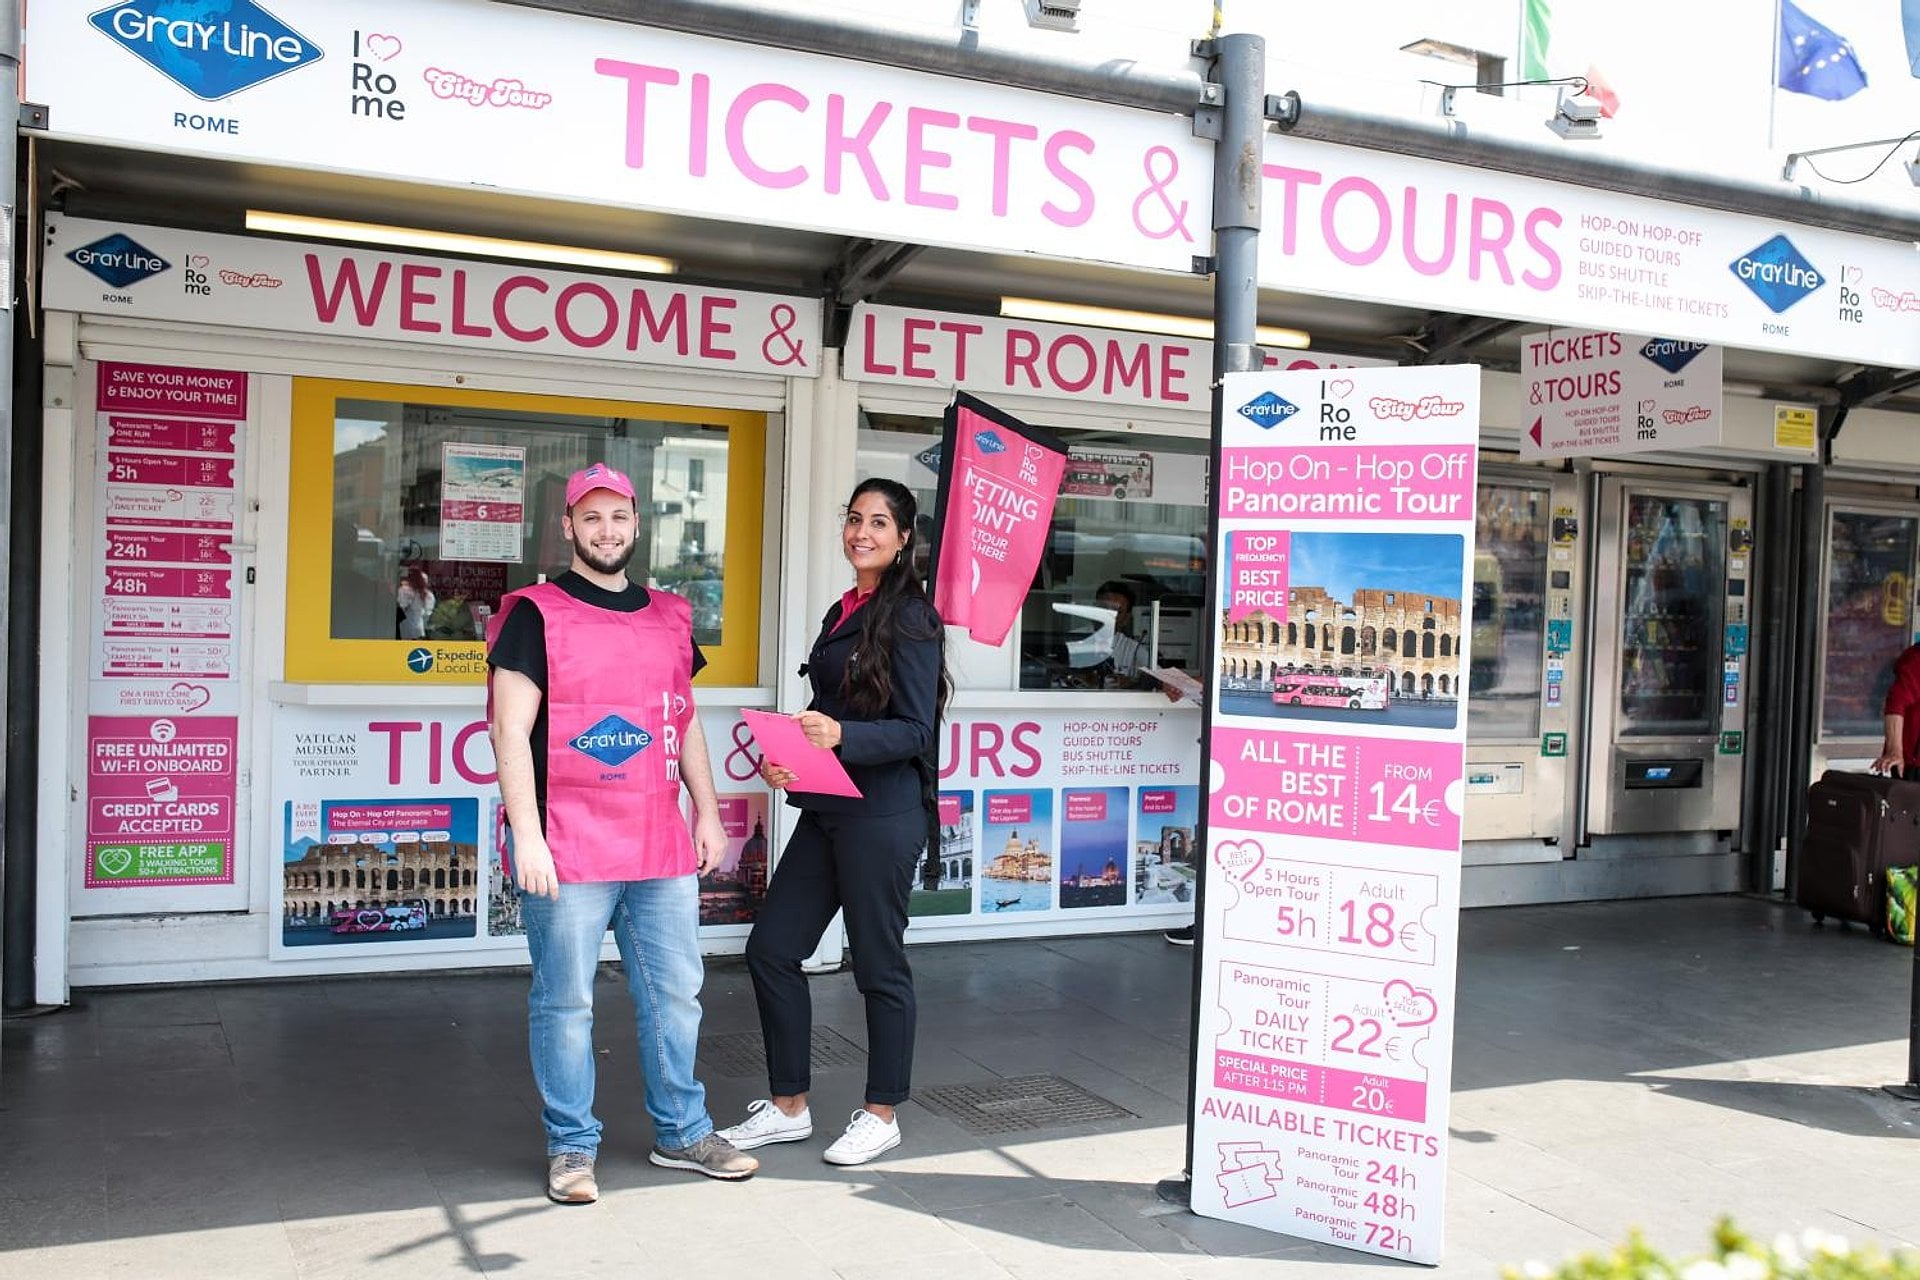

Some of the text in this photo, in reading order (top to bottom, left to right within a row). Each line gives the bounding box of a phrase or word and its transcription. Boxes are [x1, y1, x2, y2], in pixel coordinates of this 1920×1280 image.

[352, 62, 397, 94] Ro
[424, 67, 552, 109] City Tour
[351, 94, 405, 121] me
[174, 112, 239, 135] ROME
[594, 57, 1194, 242] TICKETS &
[1262, 163, 1563, 292] TOURS
[1580, 215, 1703, 247] HOP-ON HOP-OFF
[1579, 238, 1681, 267] GUIDED TOURS
[185, 269, 207, 284] Ro
[1579, 261, 1668, 288] BUS SHUTTLE
[102, 294, 134, 305] ROME
[185, 284, 211, 296] me
[1840, 287, 1860, 305] Ro
[304, 253, 808, 368] WELCOME &
[1578, 284, 1729, 319] SKIP-THE-LINE TICKETS
[1839, 306, 1863, 324] me
[1762, 323, 1790, 337] ROME
[863, 313, 1190, 402] LET ROME
[1529, 332, 1621, 367] TICKETS
[112, 370, 233, 390] SAVE YOUR MONEY
[1664, 379, 1684, 388] ROME
[107, 386, 237, 405] & ENJOY YOUR TIME!
[1320, 404, 1350, 423] Ro
[1369, 395, 1464, 422] City Tour
[1637, 416, 1654, 428] Ro
[1320, 425, 1357, 441] me
[1637, 429, 1657, 440] me
[115, 467, 137, 480] 5h
[1229, 456, 1283, 487] Hop
[1289, 454, 1330, 481] On
[1356, 453, 1414, 485] Hop
[1420, 453, 1468, 480] Off
[1227, 487, 1462, 513] Panoramic Tour
[979, 529, 1009, 551] TOUR
[1245, 536, 1277, 550] TOP
[113, 542, 147, 558] 24h
[978, 544, 1007, 562] HERE
[1235, 553, 1285, 562] FREQUENCY!
[112, 578, 147, 593] 48h
[1239, 570, 1281, 586] BEST
[1235, 590, 1284, 607] PRICE
[436, 663, 471, 673] Local
[1063, 721, 1158, 733] HOP-ON HOP-OFF
[295, 733, 356, 744] VATICAN
[1063, 736, 1142, 747] GUIDED TOURS
[96, 743, 227, 757] FREE UNLIMITED
[295, 745, 356, 755] MUSEUMS
[724, 721, 764, 781] &
[939, 722, 1042, 779] URS
[1063, 750, 1132, 761] BUS SHUTTLE
[1240, 739, 1346, 769] ALL THE
[101, 759, 223, 772] WI-FI ONBOARD
[294, 759, 315, 767] TOUR
[299, 767, 352, 777] PARTNER
[1062, 764, 1180, 775] SKIP-THE-LINE TICKETS
[600, 773, 627, 781] ROME
[1384, 764, 1433, 782] FROM
[1281, 771, 1346, 797] BEST
[102, 802, 219, 817] CREDIT CARDS
[1223, 794, 1344, 827] OF ROME
[1368, 781, 1441, 827] 14€
[118, 818, 203, 833] ACCEPTED
[139, 845, 208, 858] FREE APP
[145, 857, 218, 867] WALKING TOURS
[156, 866, 218, 875] ATTRACTIONS
[1264, 868, 1320, 887] 5 Hours
[1244, 881, 1320, 902] Open Tour
[1360, 881, 1406, 900] Adult
[1277, 906, 1316, 938] 5h
[1338, 900, 1419, 952] 18€
[1233, 970, 1311, 993] Panoramic
[1278, 993, 1311, 1010] Tour
[1353, 1004, 1386, 1018] Adult
[1255, 1009, 1309, 1032] DAILY
[1239, 1029, 1309, 1055] TICKET
[1331, 1014, 1402, 1060] 22€
[1218, 1055, 1309, 1082] SPECIAL PRICE
[1223, 1072, 1259, 1088] AFTER
[1288, 1081, 1307, 1095] PM
[1362, 1075, 1389, 1089] Adult
[1351, 1086, 1394, 1114] 20€
[1201, 1096, 1439, 1157] AVAILABLE TICKETS
[1297, 1146, 1360, 1167] Panoramic
[1332, 1165, 1360, 1180] Tour
[1365, 1160, 1416, 1190] 24h
[1296, 1176, 1358, 1198] Panoramic
[1330, 1195, 1358, 1210] Tour
[1363, 1191, 1416, 1222] 48h
[1295, 1207, 1357, 1230] Panoramic
[1330, 1227, 1357, 1242] Tour
[1364, 1222, 1412, 1253] 72h
